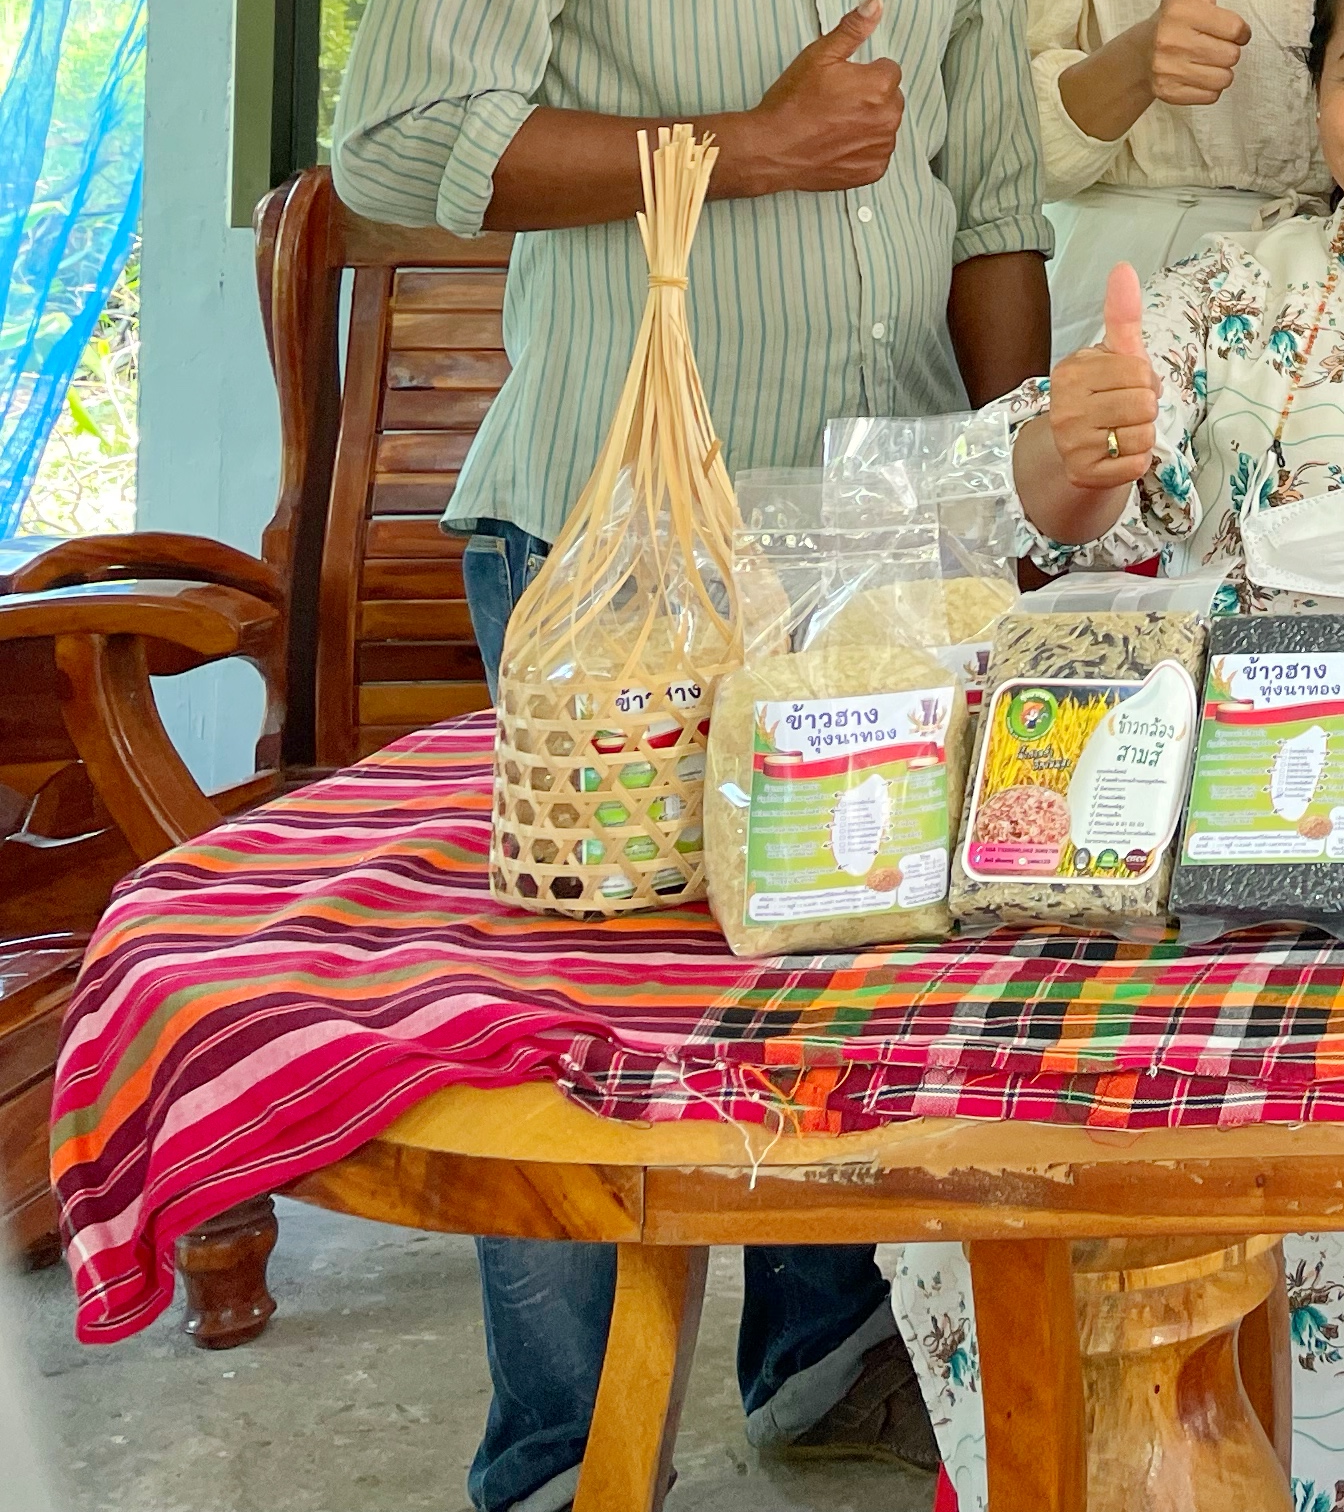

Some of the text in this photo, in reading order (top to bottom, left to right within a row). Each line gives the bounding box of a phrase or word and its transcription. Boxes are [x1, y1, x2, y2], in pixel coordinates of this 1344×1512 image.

[1243, 656, 1327, 680] ข้าวฮาง
[1259, 680, 1341, 703] ทุ่งนาทอง
[786, 703, 879, 730] ข้าวฮาง
[1118, 714, 1175, 739] ข้าวกล้อง
[807, 728, 897, 754] ทุ่งนาทอง
[1116, 742, 1165, 767] สามสี
